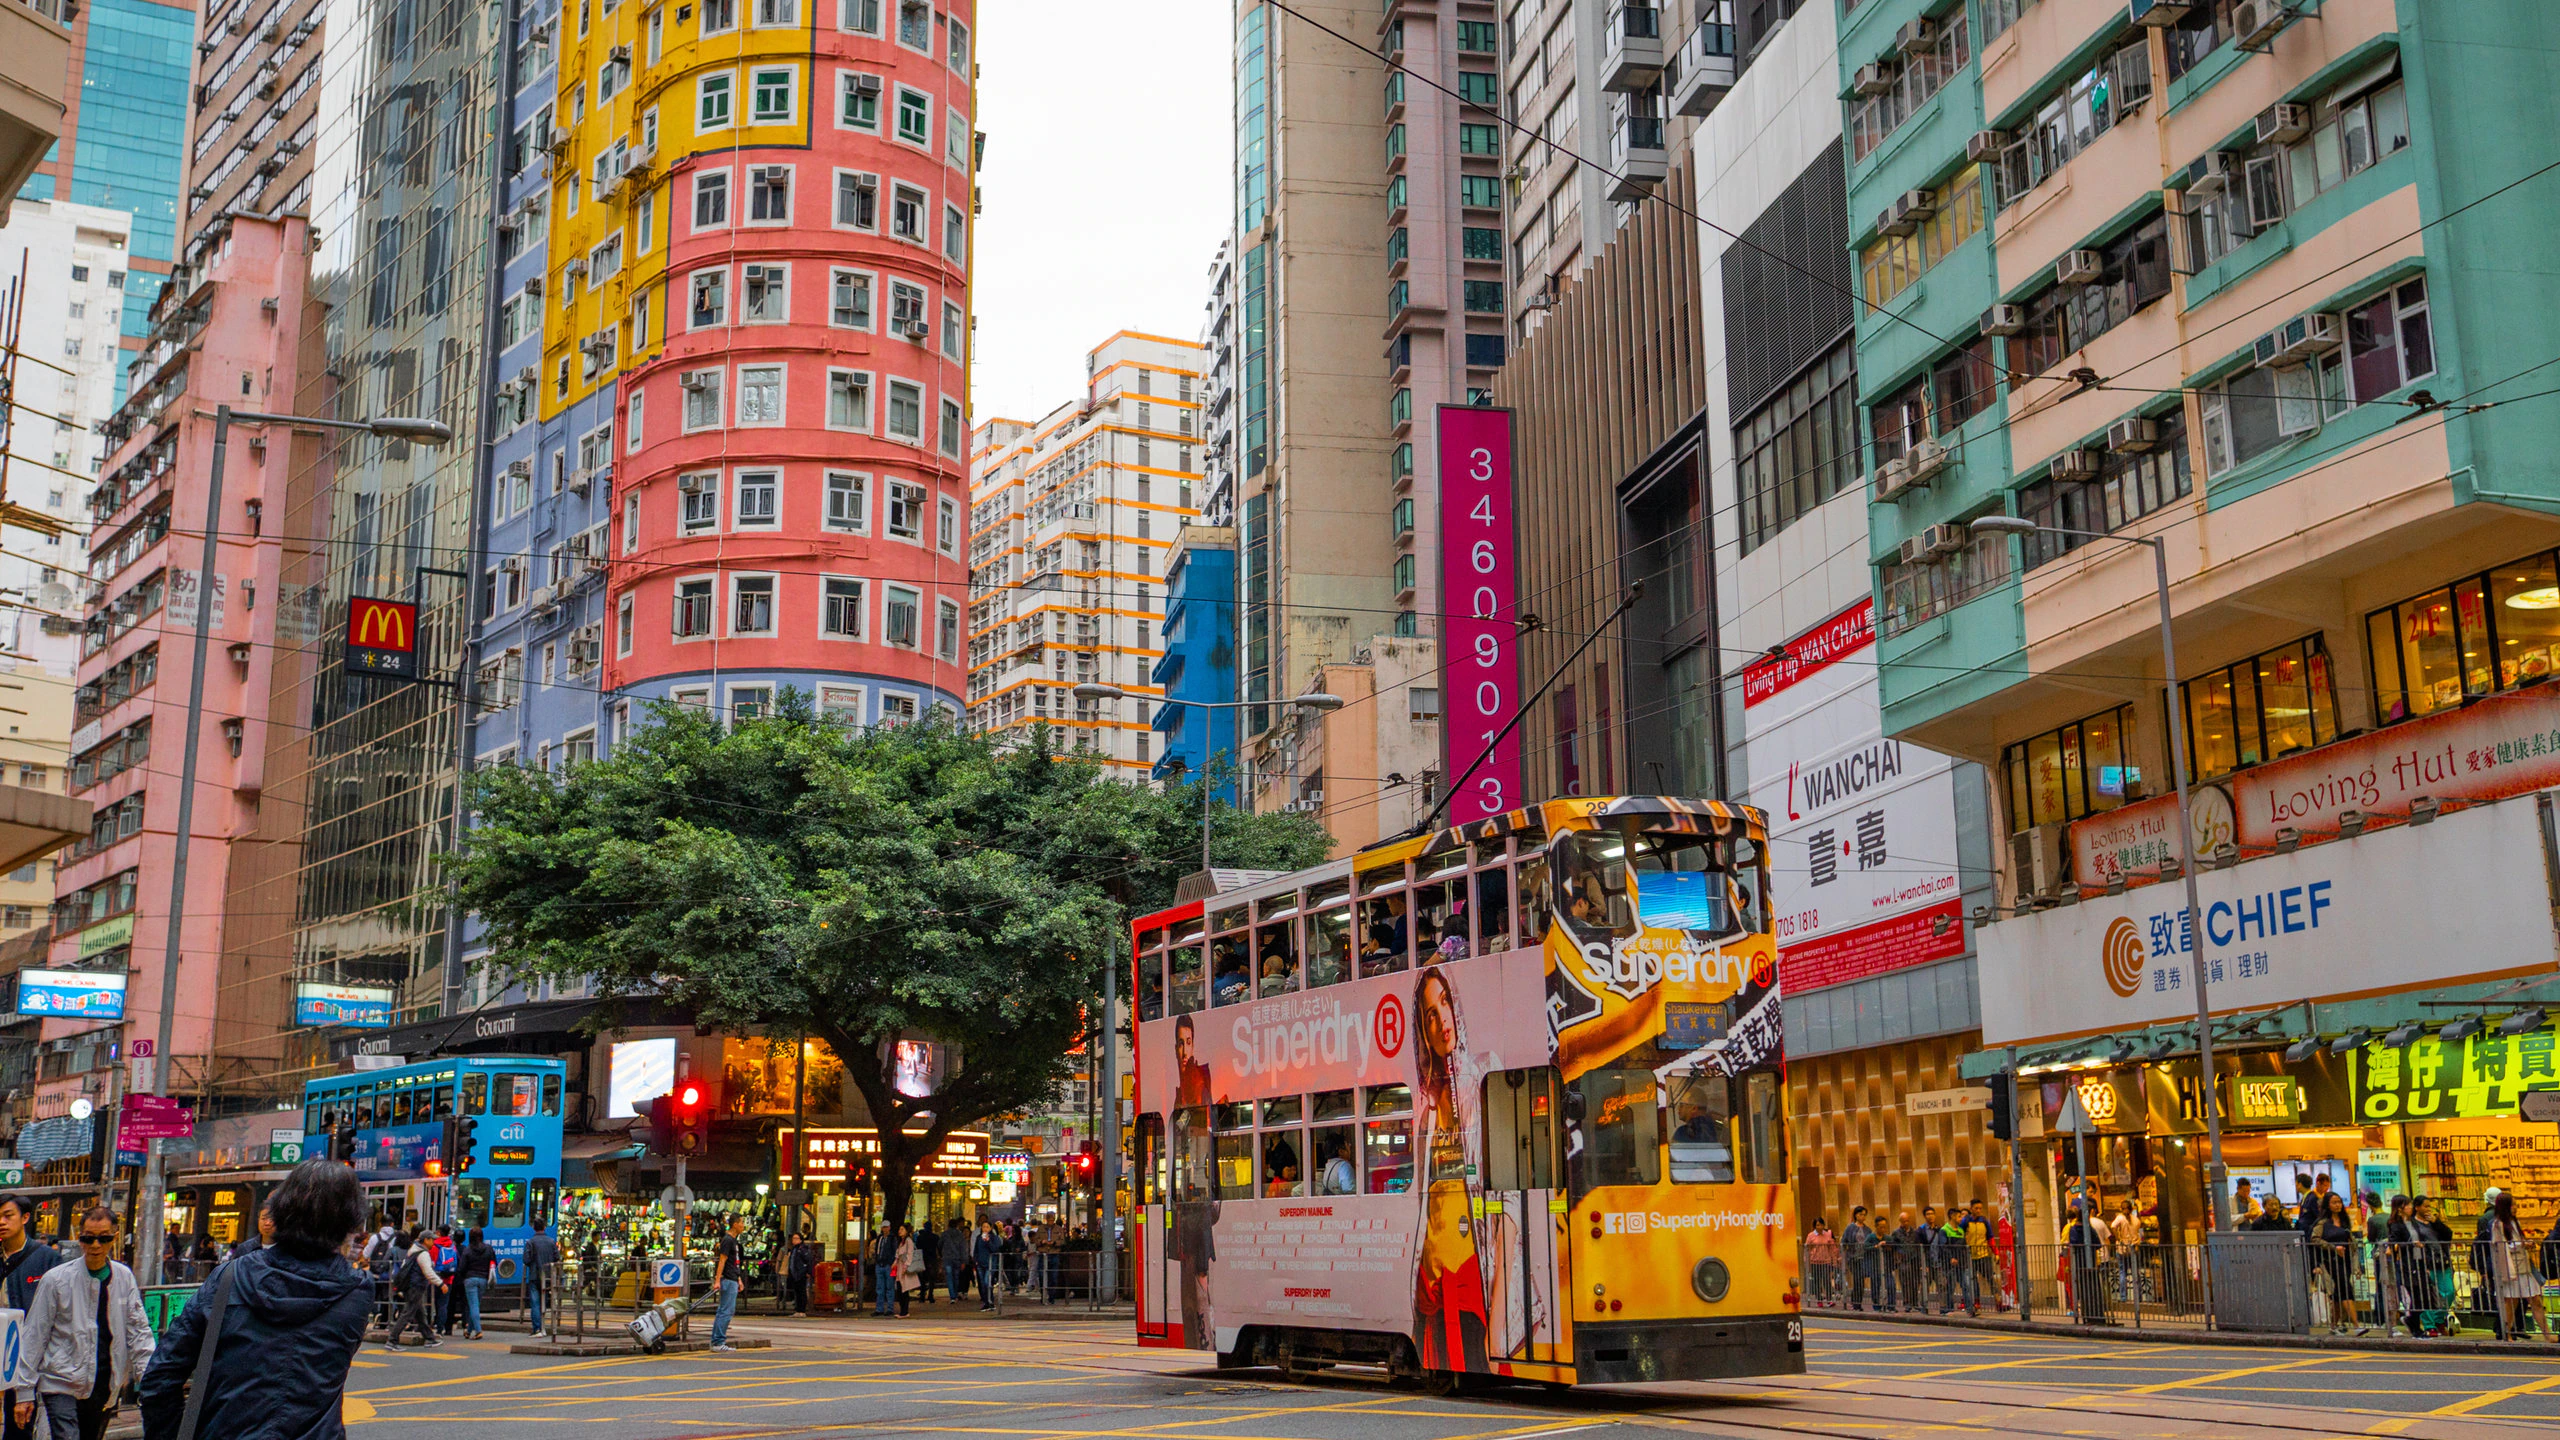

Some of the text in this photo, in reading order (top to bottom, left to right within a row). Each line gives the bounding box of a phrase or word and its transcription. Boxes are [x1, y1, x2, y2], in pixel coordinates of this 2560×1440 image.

[1469, 447, 1503, 813] 34609013
[2407, 604, 2441, 644] 2/F
[382, 654, 400, 669] 24
[1747, 669, 1775, 698] Living
[1785, 658, 1799, 682] up
[1799, 631, 1830, 668] WAN
[1831, 612, 1863, 651] CHAI
[1803, 739, 1902, 811] WANCHAI
[2271, 743, 2457, 823] Loving Hut
[1586, 802, 1608, 815] 29
[2091, 823, 2136, 850] Loving
[1872, 875, 1954, 908] www.L-wanchai.com
[1775, 909, 1818, 938] 705 1818
[2207, 880, 2331, 946] CHIEF
[1665, 1003, 1723, 1015] Shaukeiwan
[476, 1013, 516, 1038] Gourami
[358, 1035, 391, 1056] Gourami
[2240, 1082, 2288, 1105] HKT
[2364, 1081, 2560, 1119] OUTL
[500, 1126, 525, 1140] citi
[1280, 1206, 1333, 1217] SUPERDRY MAINLINE
[1649, 1209, 1784, 1232] SuperdryHongKong
[1284, 1288, 1331, 1298] SUPERDRY SPORT
[1787, 1320, 1802, 1341] 29
